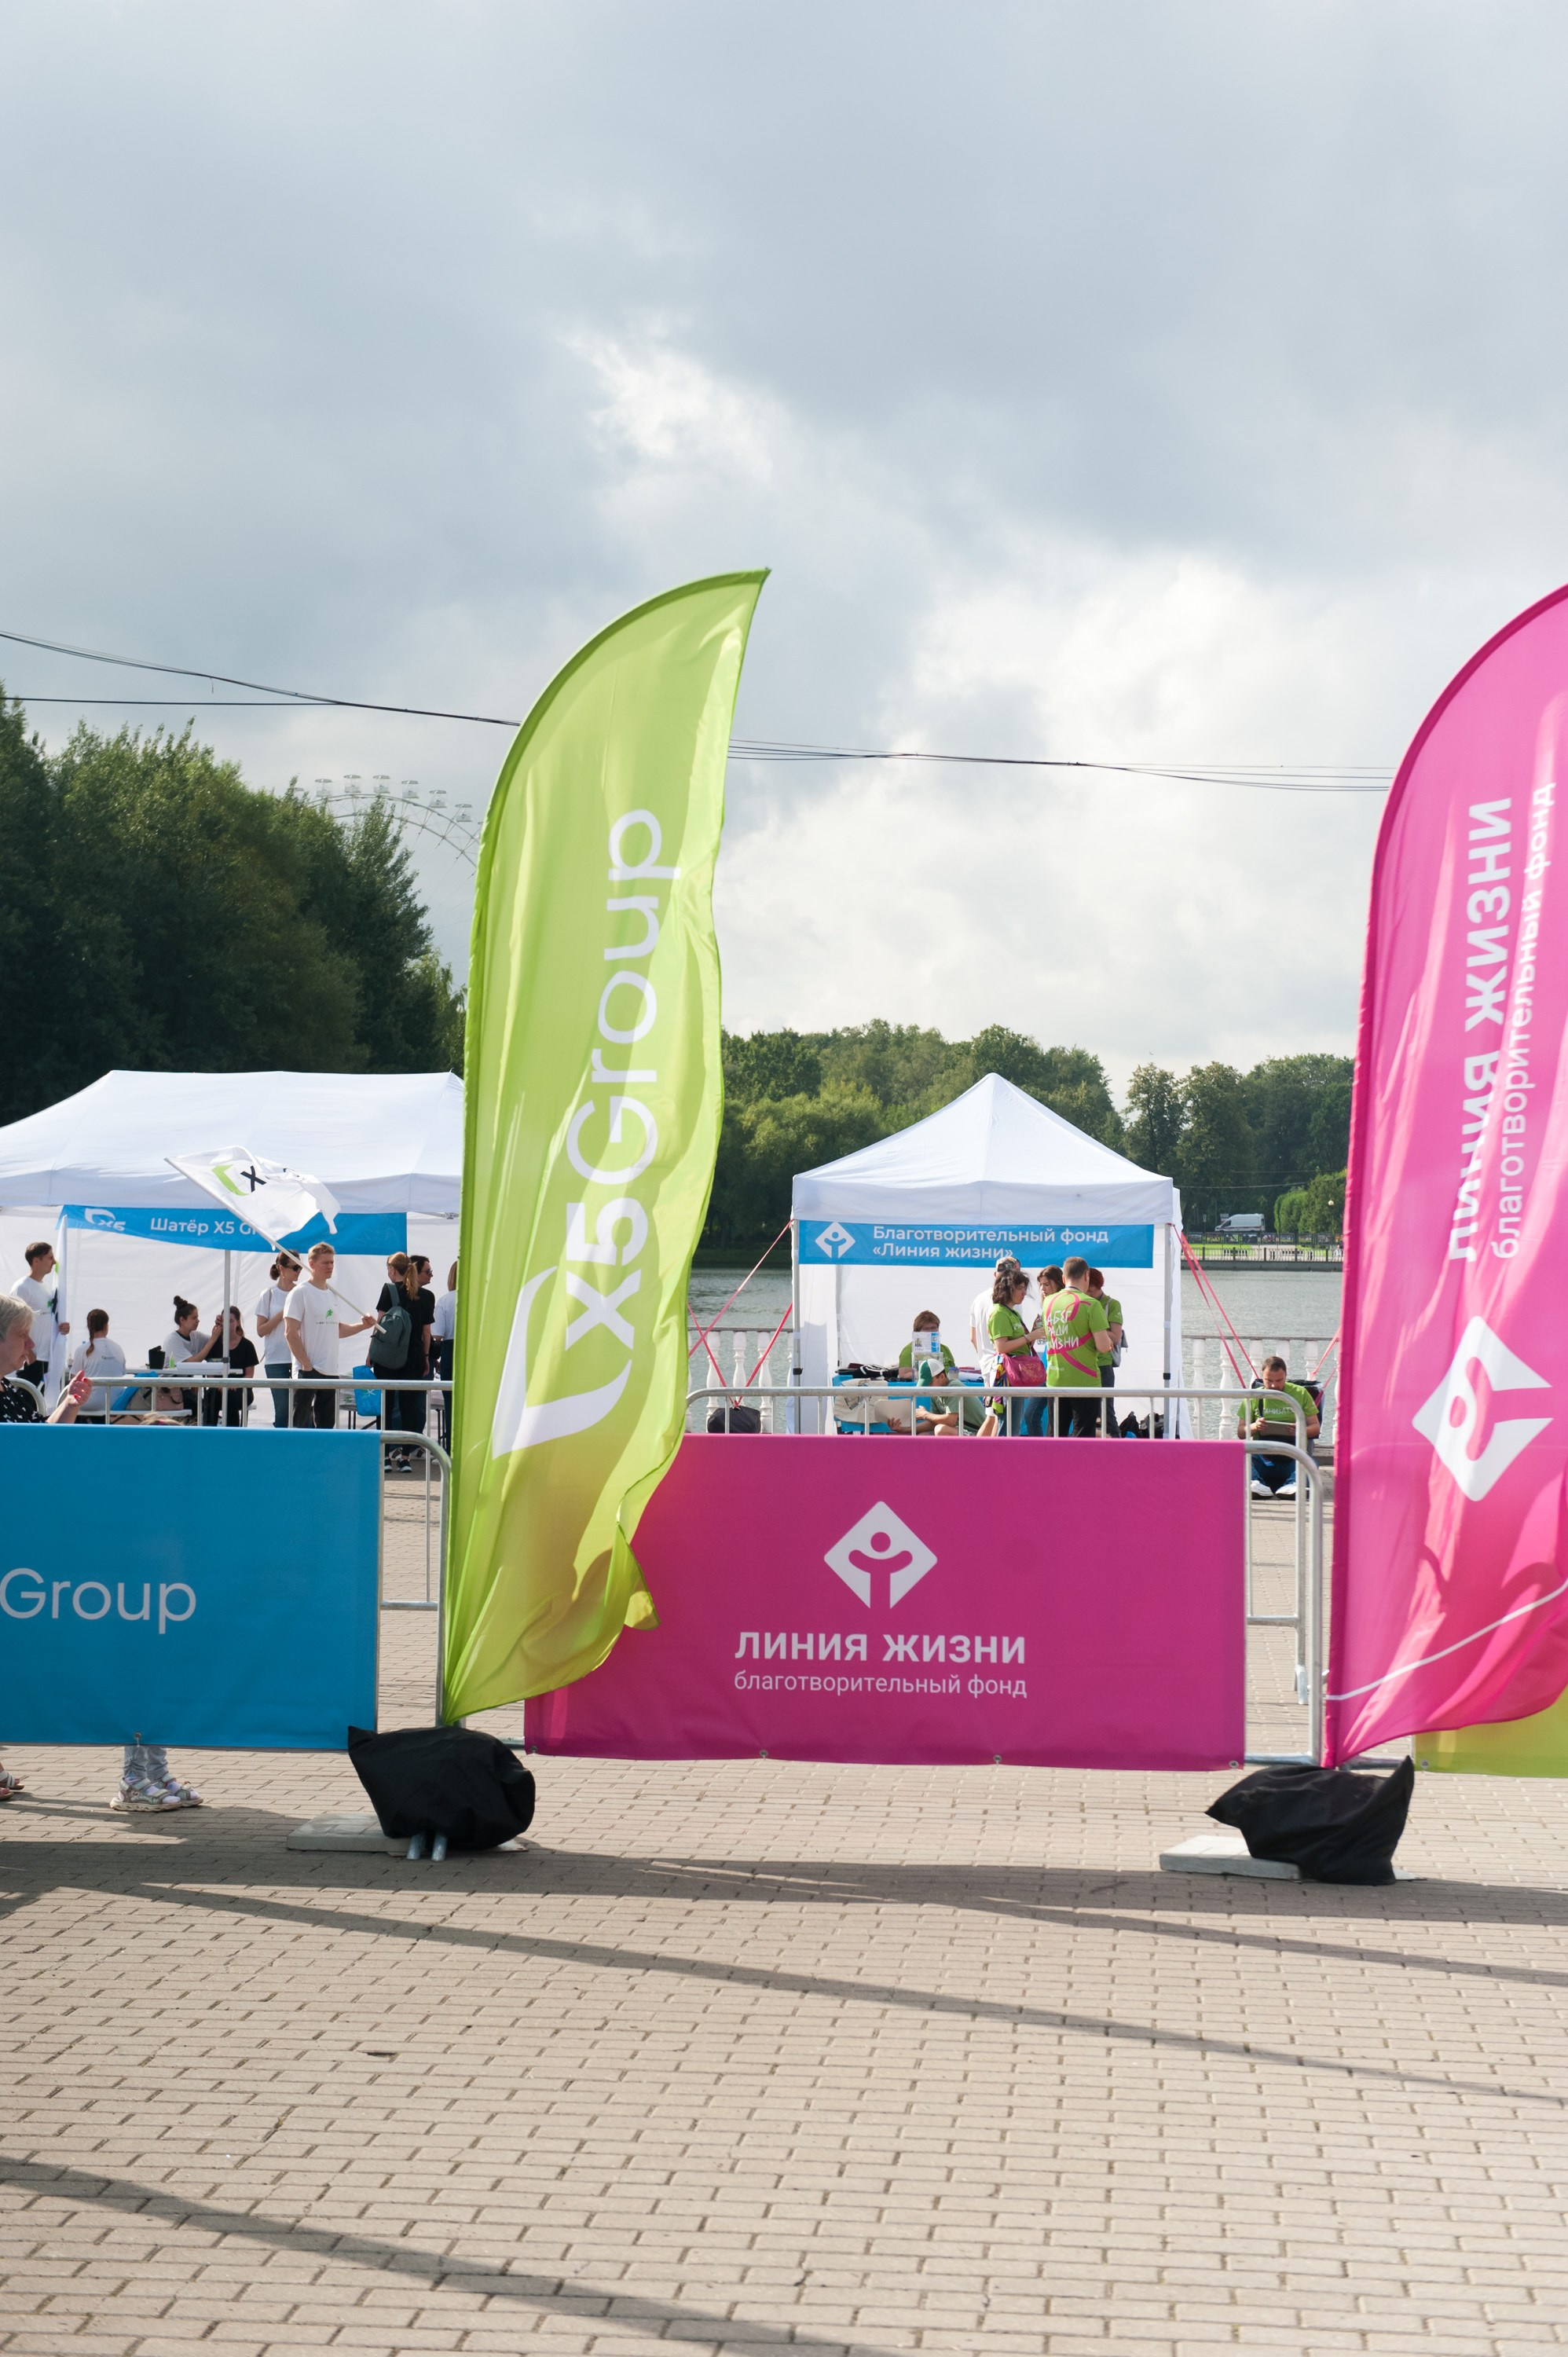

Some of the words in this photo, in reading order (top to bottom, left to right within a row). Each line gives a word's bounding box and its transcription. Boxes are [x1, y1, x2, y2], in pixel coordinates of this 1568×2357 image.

[1464, 797, 1512, 1033] ЖИЗНИ
[1490, 889, 1543, 1259] благотворительный
[1523, 782, 1557, 880] фонд
[240, 1165, 267, 1193] X
[150, 1218, 209, 1236] Шатёр
[874, 1226, 1055, 1244] Благотворительный
[1061, 1228, 1108, 1245] фонд
[873, 1243, 940, 1257] «Линия
[945, 1248, 1013, 1259] жизни»
[1046, 1310, 1072, 1325] АБЕГ
[735, 1631, 867, 1661] ЛИНИЯ
[882, 1633, 1025, 1664] ЖИЗНИ
[734, 1670, 961, 1697] благотворительный
[968, 1673, 1028, 1699] фонд
